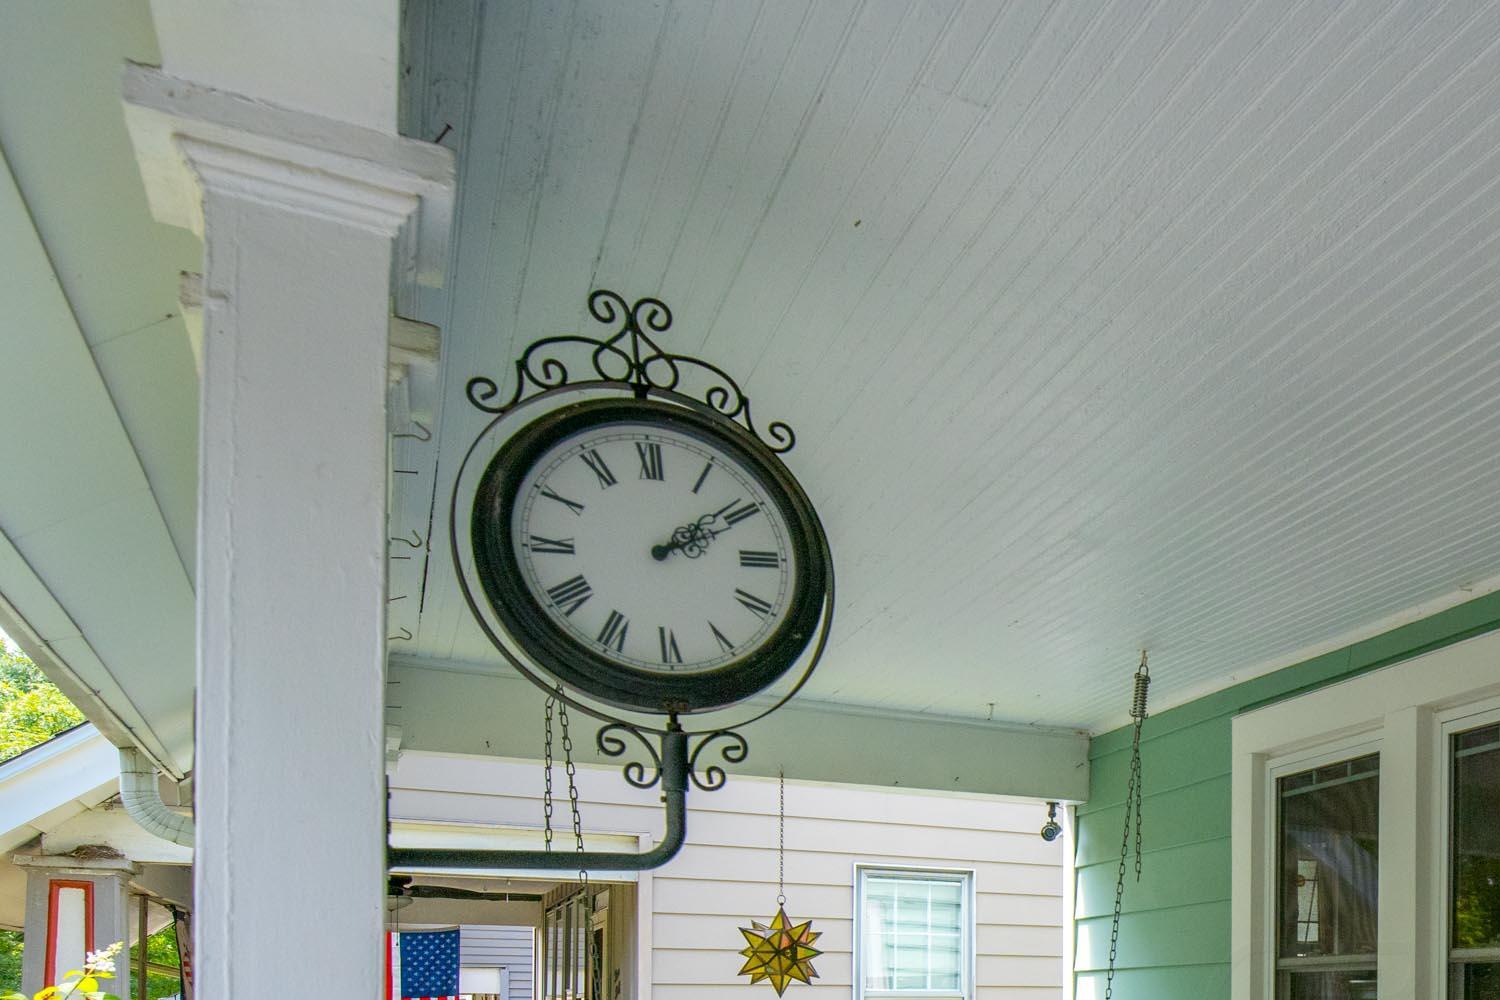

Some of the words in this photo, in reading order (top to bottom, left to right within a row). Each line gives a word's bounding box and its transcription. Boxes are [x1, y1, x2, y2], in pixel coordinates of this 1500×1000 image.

[579, 448, 618, 489] XI
[636, 441, 665, 481] XII
[692, 462, 713, 494] I
[540, 485, 584, 516] X
[723, 501, 761, 527] II
[530, 535, 576, 555] IX
[739, 550, 780, 569] III
[546, 574, 594, 617] VIII
[733, 587, 772, 621] IV
[596, 609, 630, 653] VII
[658, 626, 683, 664] VI
[707, 620, 735, 654] V
